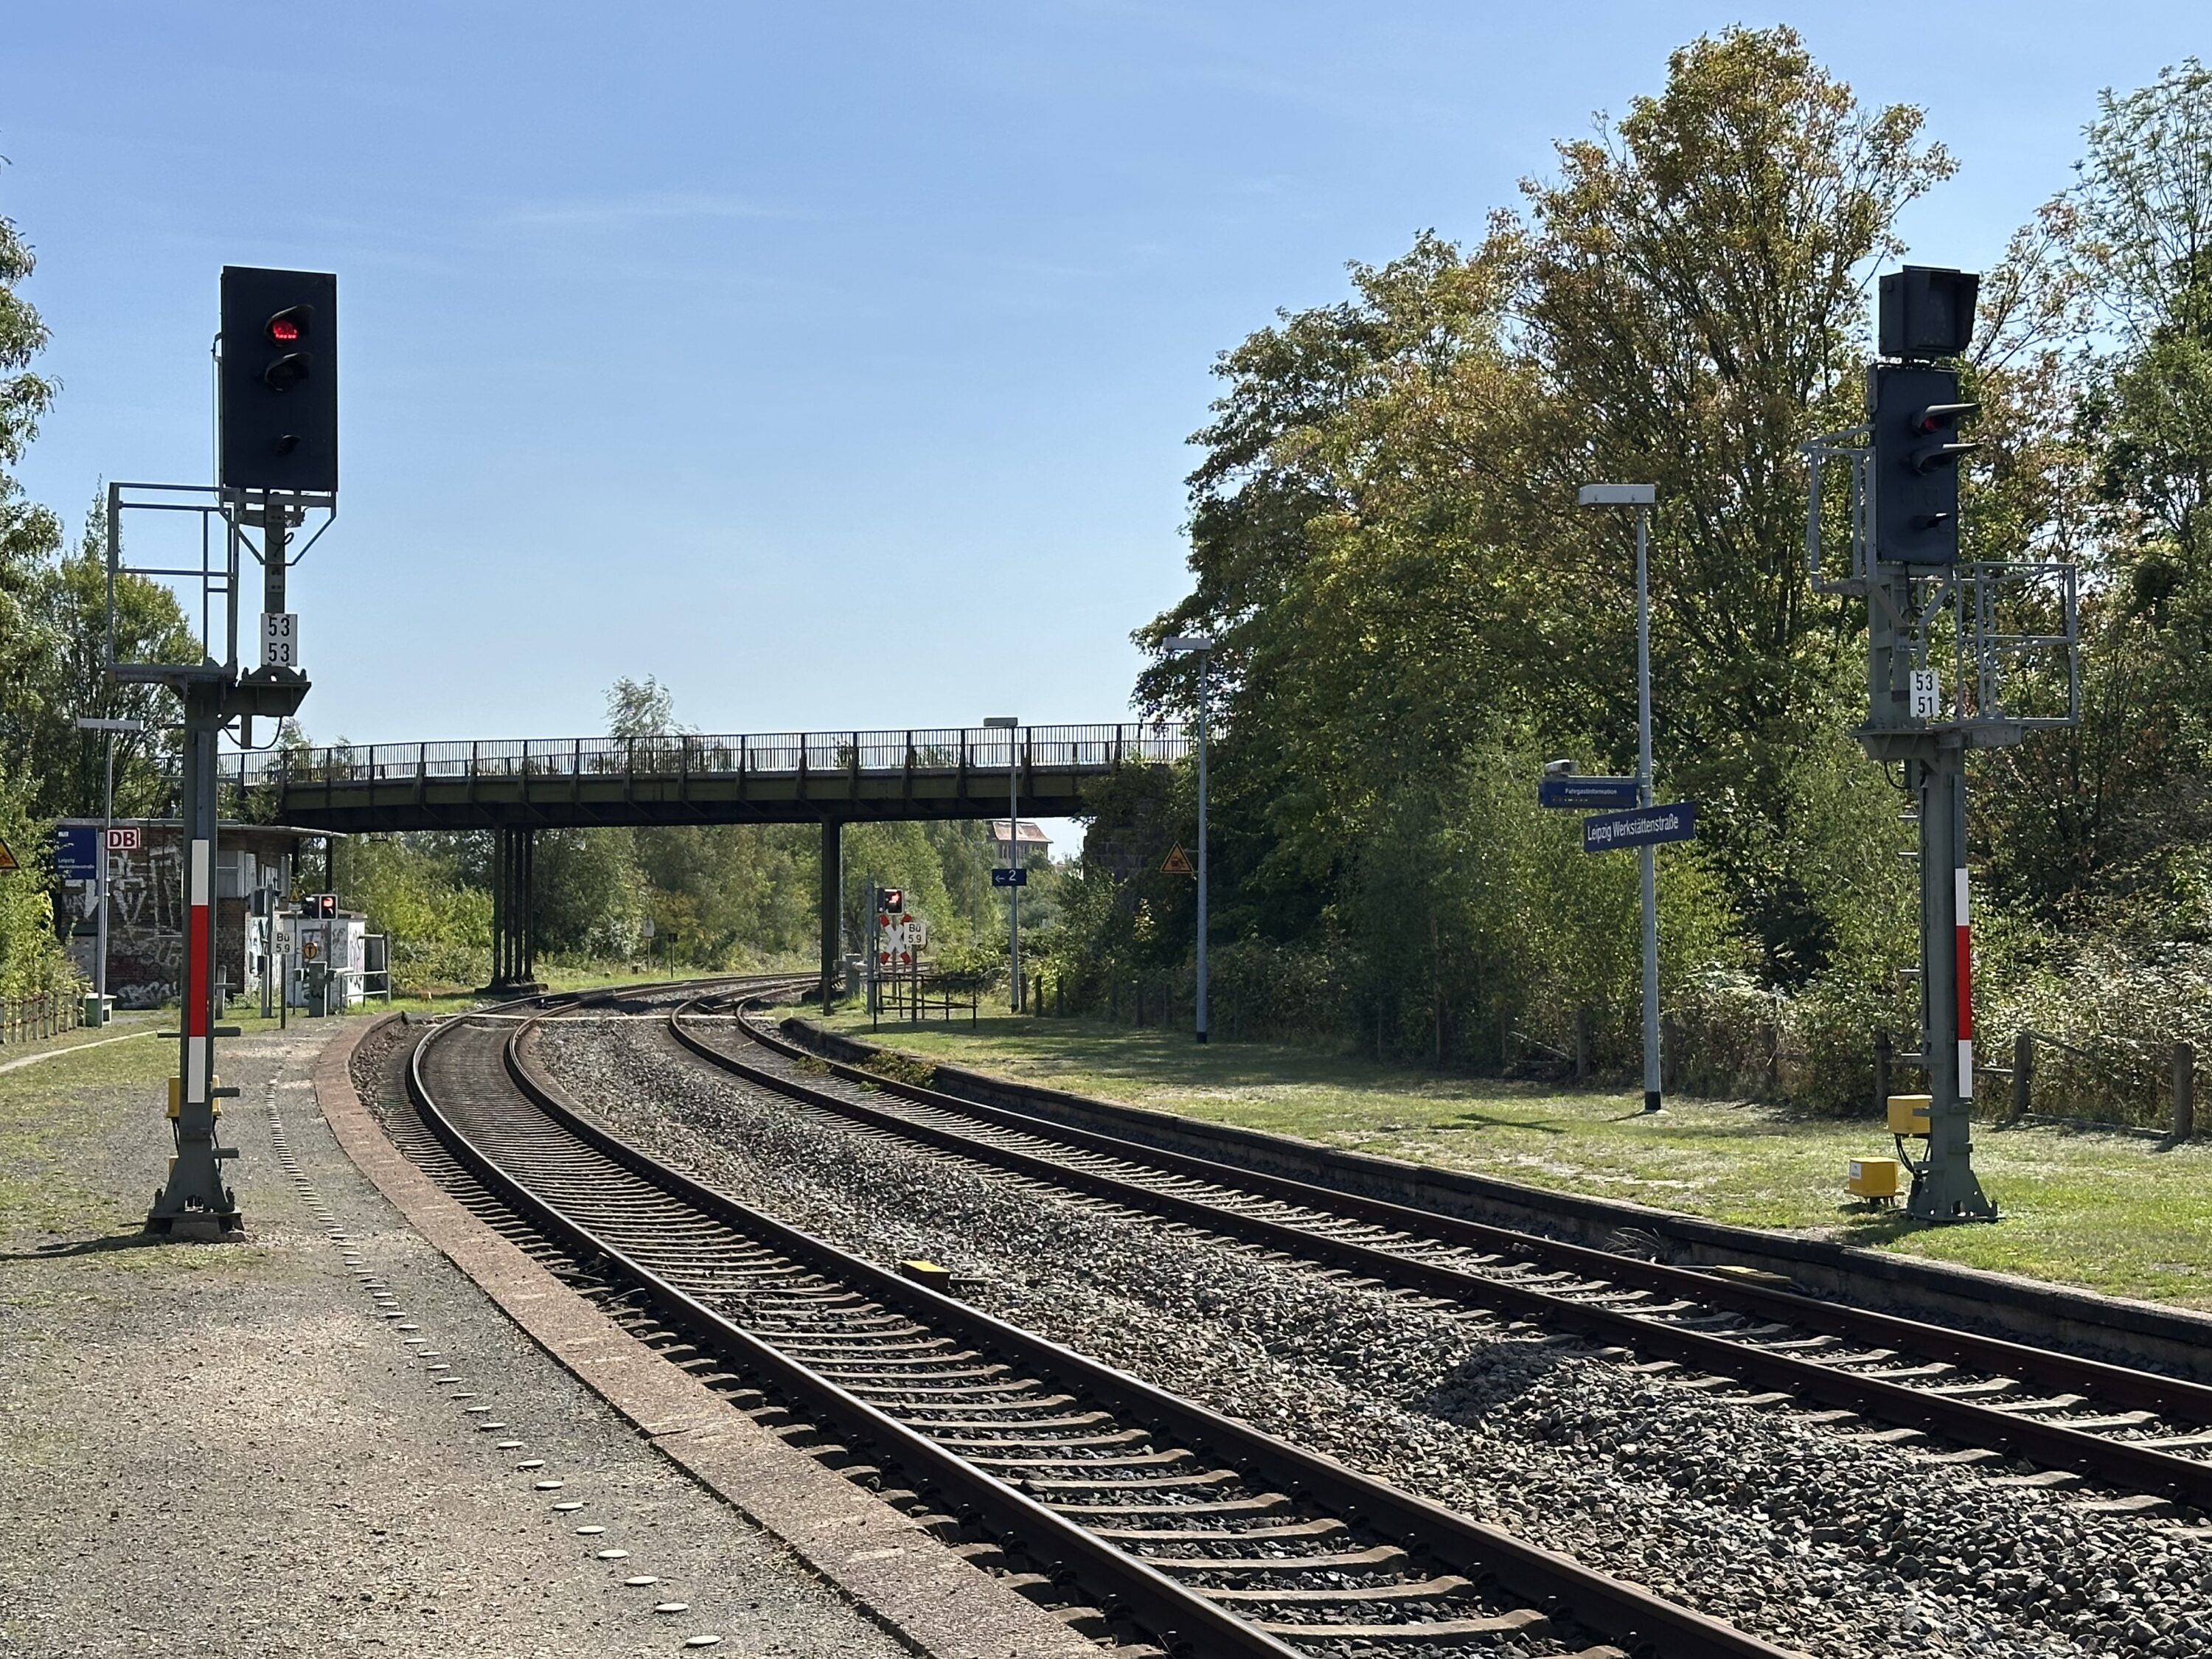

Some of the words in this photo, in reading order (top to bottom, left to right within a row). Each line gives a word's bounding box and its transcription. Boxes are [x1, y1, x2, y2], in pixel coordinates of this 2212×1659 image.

[268, 617, 290, 637] 53
[268, 642, 290, 662] 53
[1916, 673, 1933, 691] 53
[1918, 696, 1933, 714] 51
[1587, 824, 1612, 843] Leipzig
[1613, 813, 1679, 837] Werkstättenstraße
[109, 831, 136, 847] DB
[1009, 870, 1016, 881] 2
[908, 934, 922, 944] 5.9
